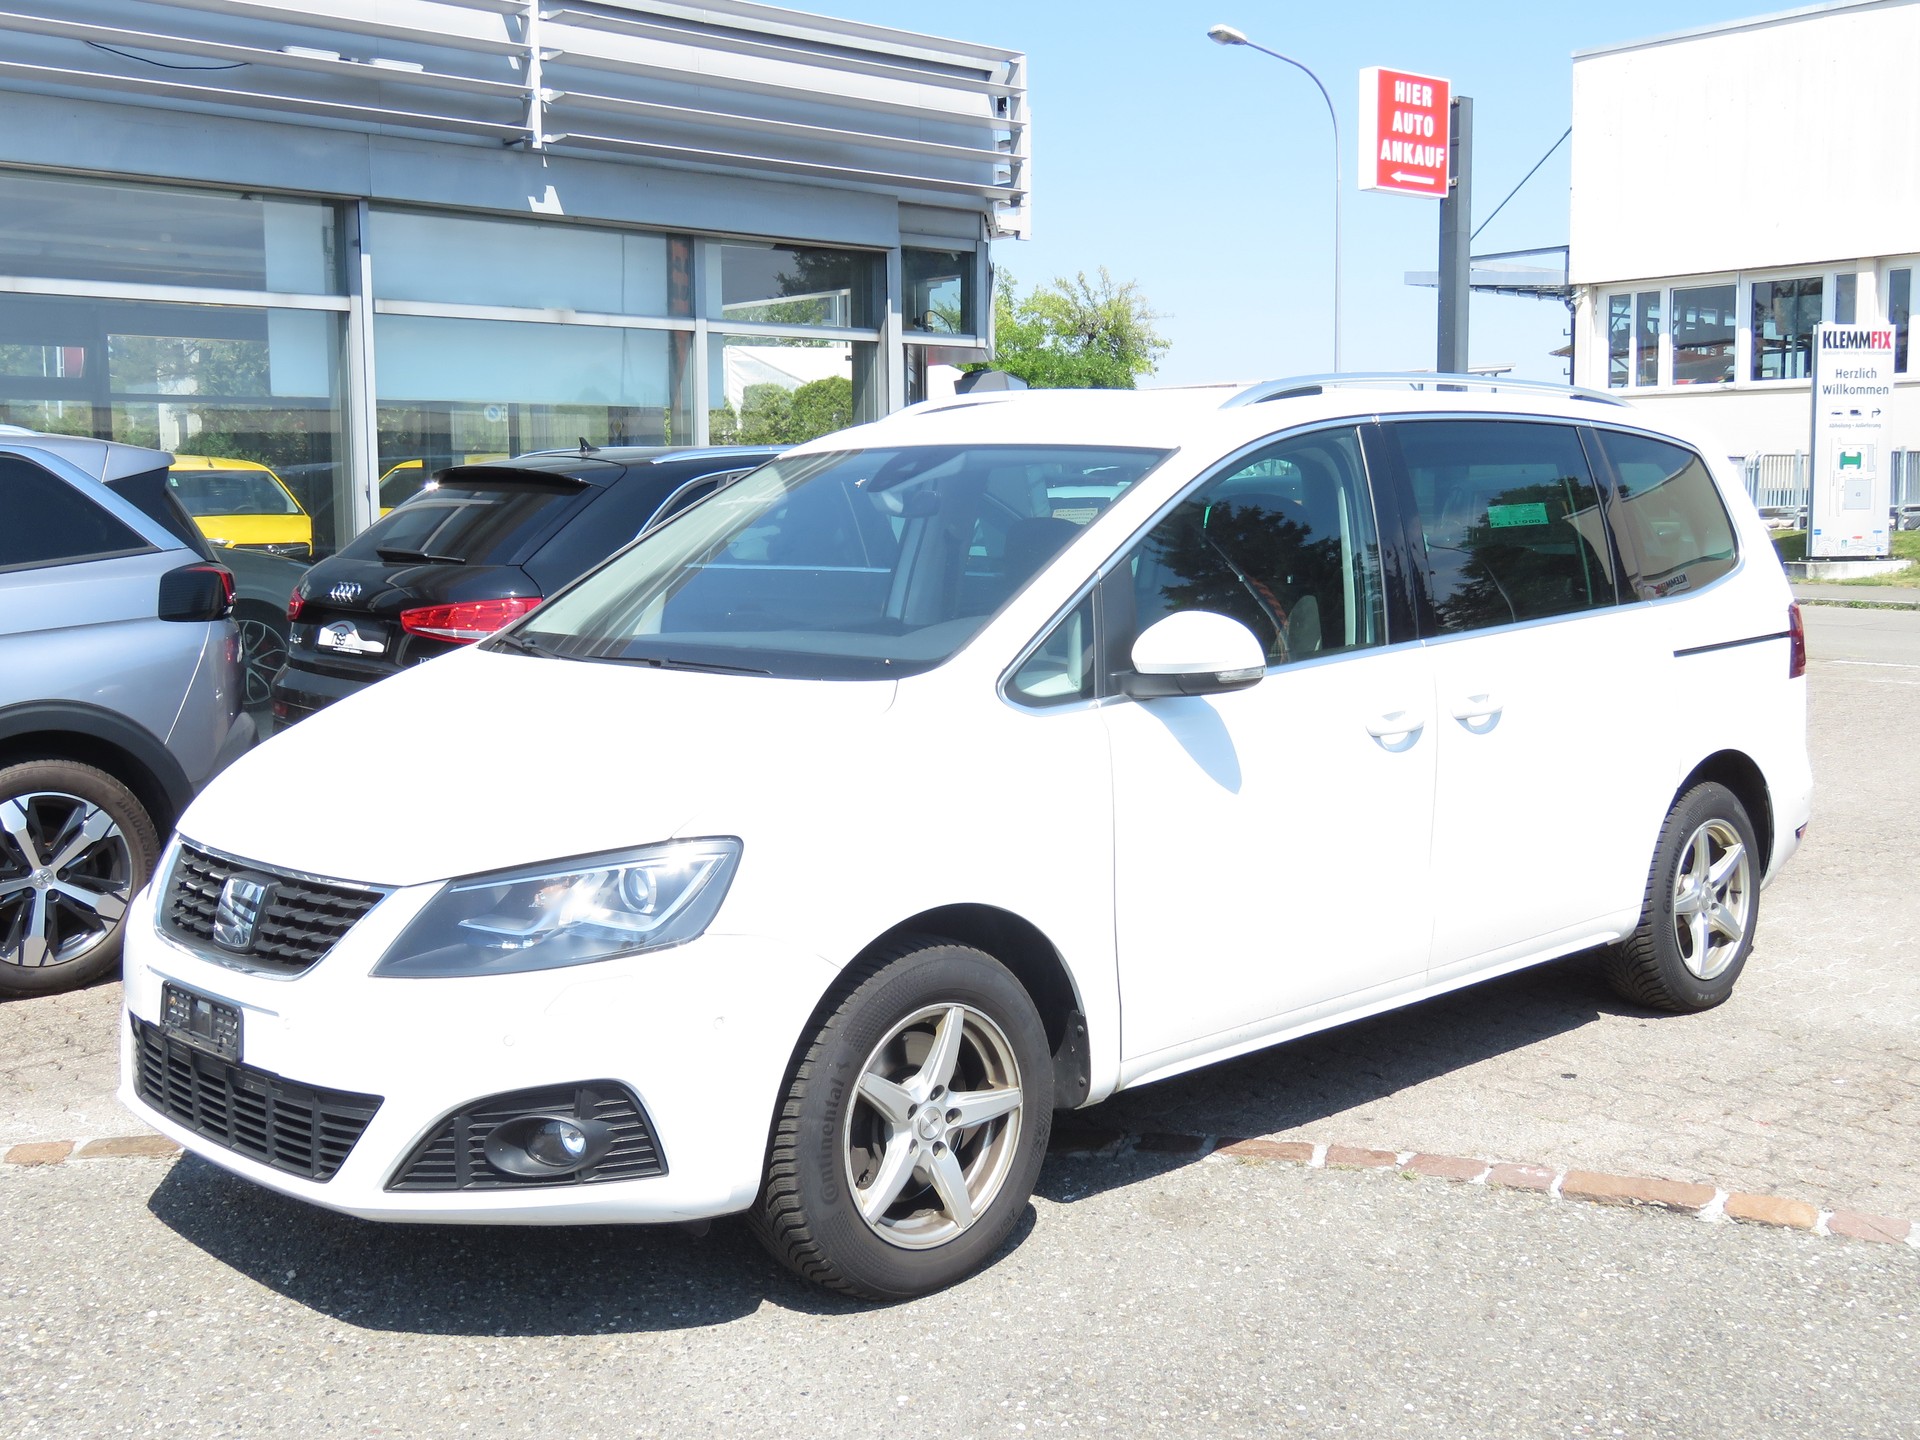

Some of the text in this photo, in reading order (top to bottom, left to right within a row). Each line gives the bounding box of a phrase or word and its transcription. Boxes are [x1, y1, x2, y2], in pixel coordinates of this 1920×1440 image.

[1395, 80, 1432, 108] HIER
[1392, 110, 1434, 138] AUTO
[1380, 139, 1445, 168] ANKAUF
[1822, 330, 1892, 349] KLEMMFIX
[1835, 367, 1877, 379] Herzlich
[1822, 383, 1889, 395] Willkommen
[822, 1076, 845, 1207] Continental
